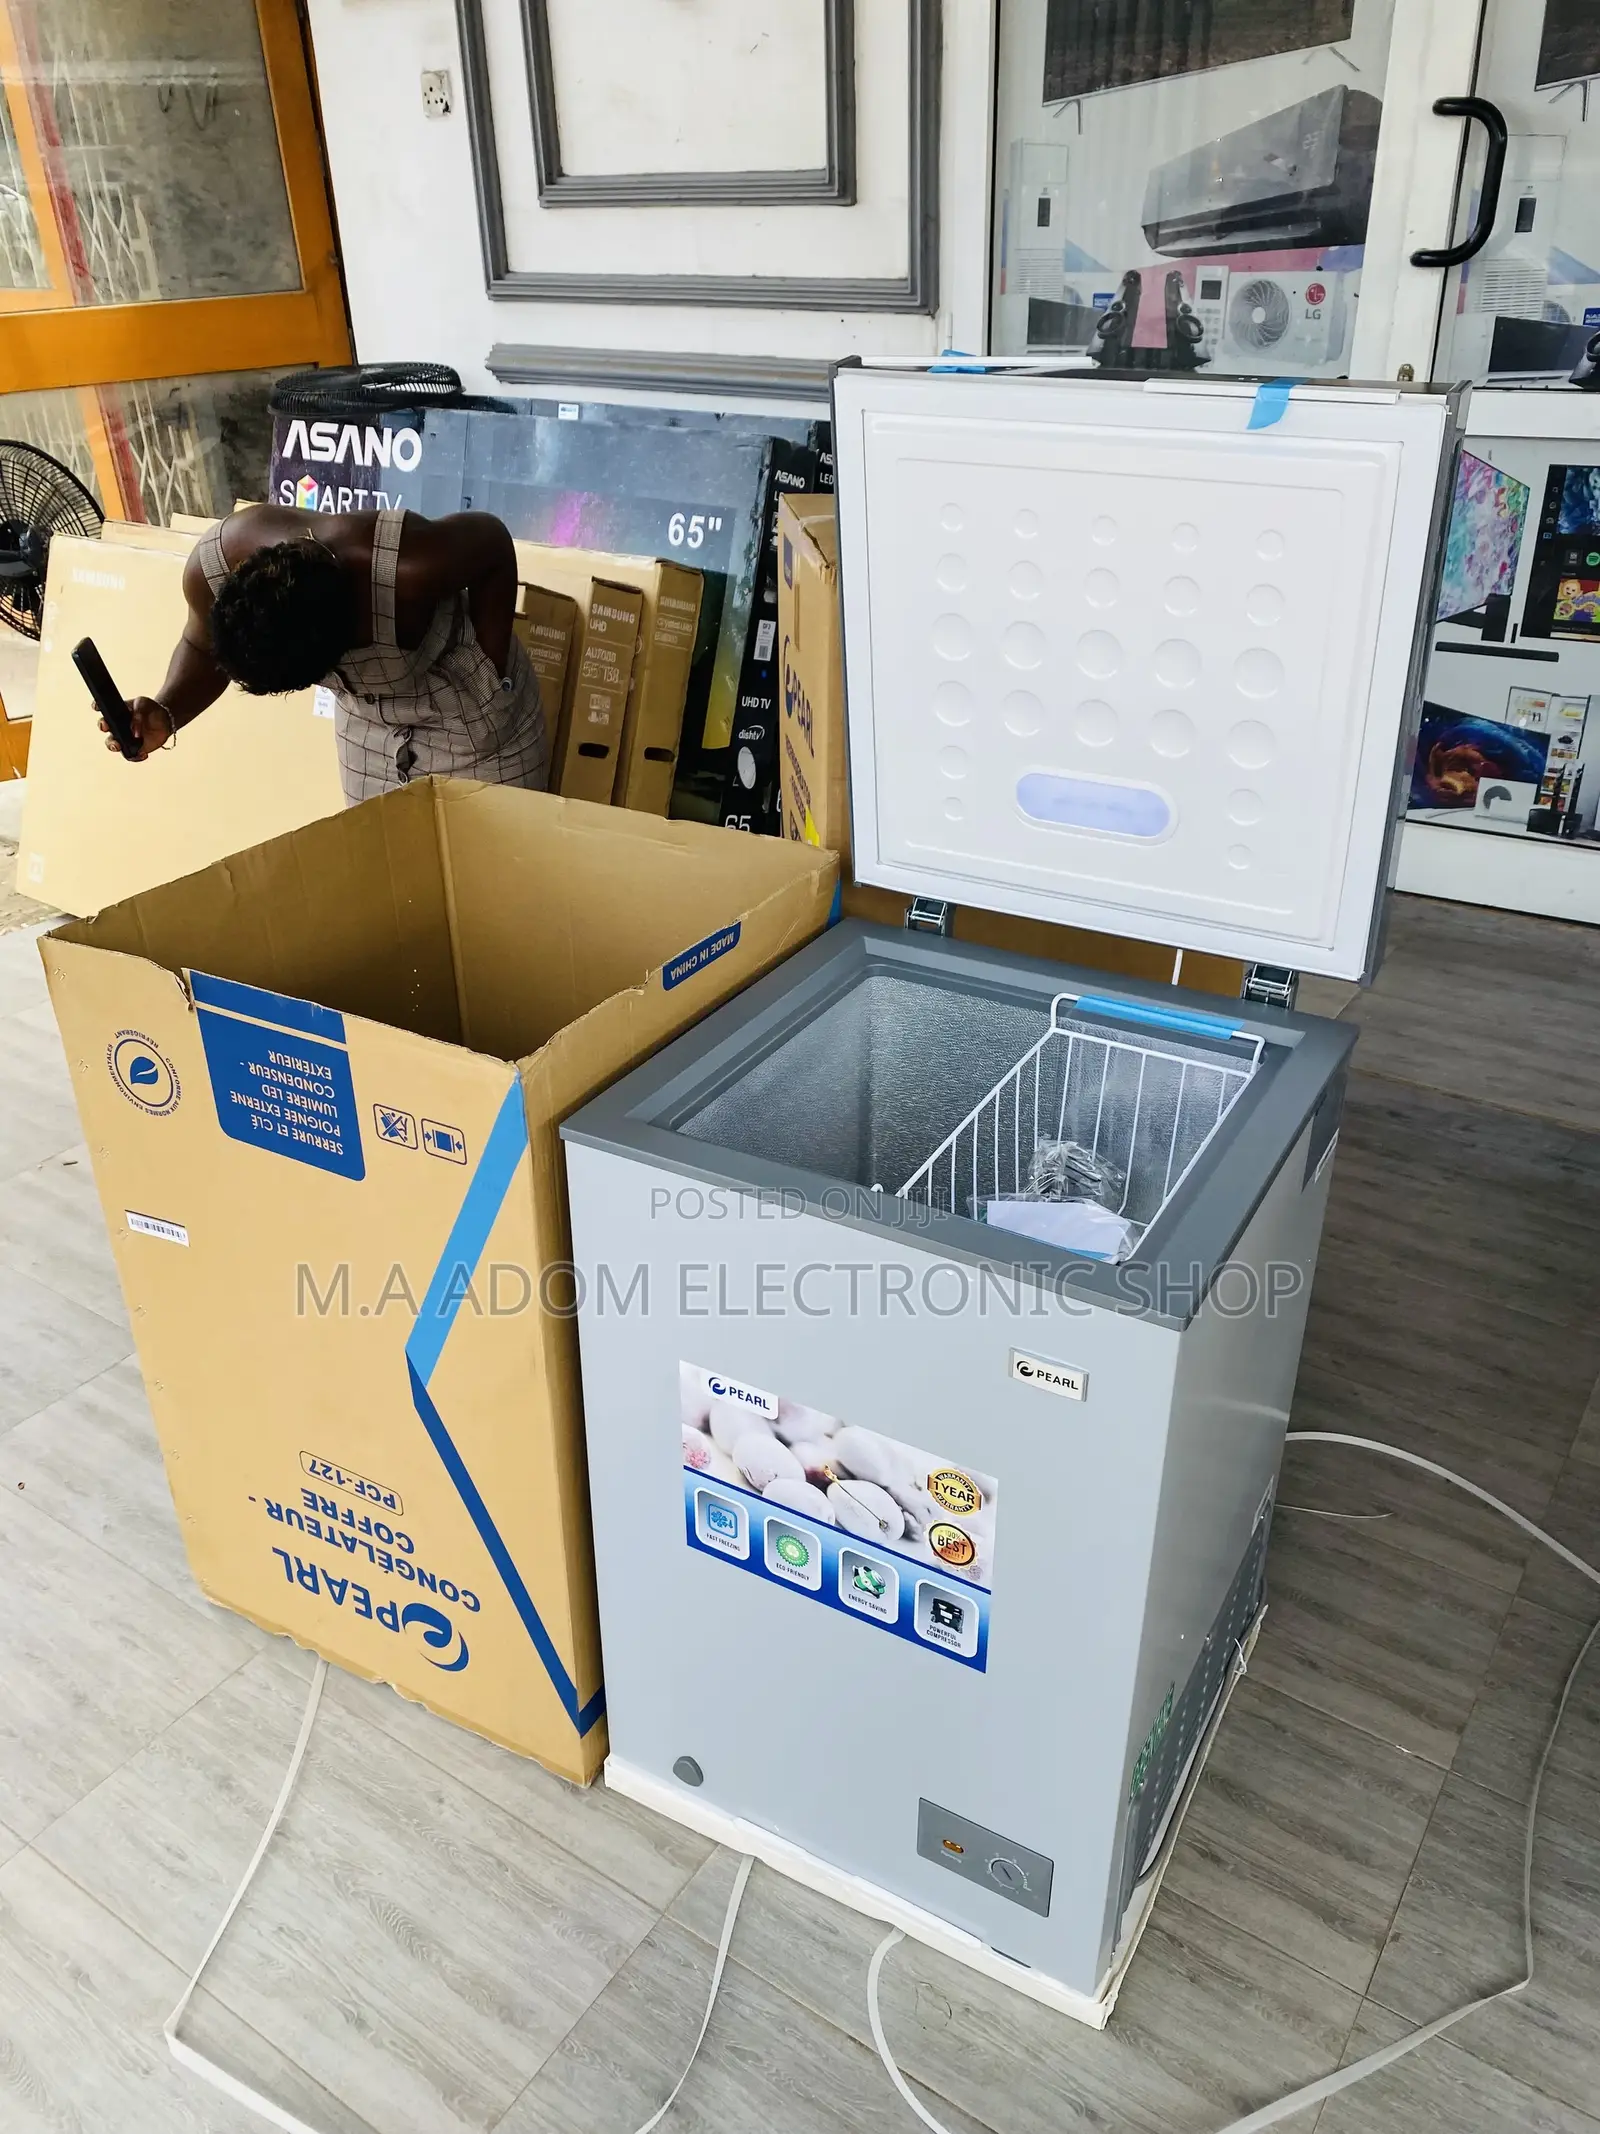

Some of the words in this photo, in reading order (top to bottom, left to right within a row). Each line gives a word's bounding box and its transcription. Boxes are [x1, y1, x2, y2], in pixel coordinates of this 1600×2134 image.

[1305, 308, 1322, 320] LG
[281, 419, 423, 473] ASANO
[774, 469, 806, 489] ASANO
[668, 512, 723, 549] 65"
[591, 603, 635, 624] SAMSUNG
[589, 619, 607, 633] UHD
[741, 695, 760, 708] UHD
[760, 697, 772, 710] TV
[700, 947, 709, 963] IN
[710, 931, 735, 956] MADE
[670, 955, 698, 981] CHINA
[267, 1049, 333, 1080] EXTÉRIEUR
[165, 1057, 182, 1100] CONFORME
[247, 1061, 335, 1099] CONDENSEUR
[229, 1090, 282, 1118] EXTERNE
[261, 1084, 284, 1101] LED
[145, 1107, 171, 1117] NORMES
[286, 1091, 338, 1119] LUMIÈRE
[250, 1114, 274, 1132] CLÉ
[276, 1122, 289, 1137] ET
[284, 1108, 341, 1137] POIGNÉE
[292, 1127, 344, 1156] SERRURE
[1036, 1369, 1079, 1390] PEARL
[728, 1386, 770, 1411] PEARL
[307, 1456, 398, 1511] PCF-127
[933, 1481, 939, 1491] 1
[941, 1483, 975, 1505] YEAR
[299, 1487, 416, 1555] COFFRE
[706, 1532, 718, 1542] FAST
[718, 1537, 741, 1552] FREEZING
[937, 1534, 967, 1556] BEST
[263, 1496, 482, 1614] CONGÉLATEUR
[271, 1546, 402, 1634] PEARL
[848, 1593, 868, 1606] ENERGY
[868, 1601, 888, 1615] SAVING
[926, 1629, 962, 1648] COMPRESSOR
[929, 1624, 957, 1641] POWERFUL
